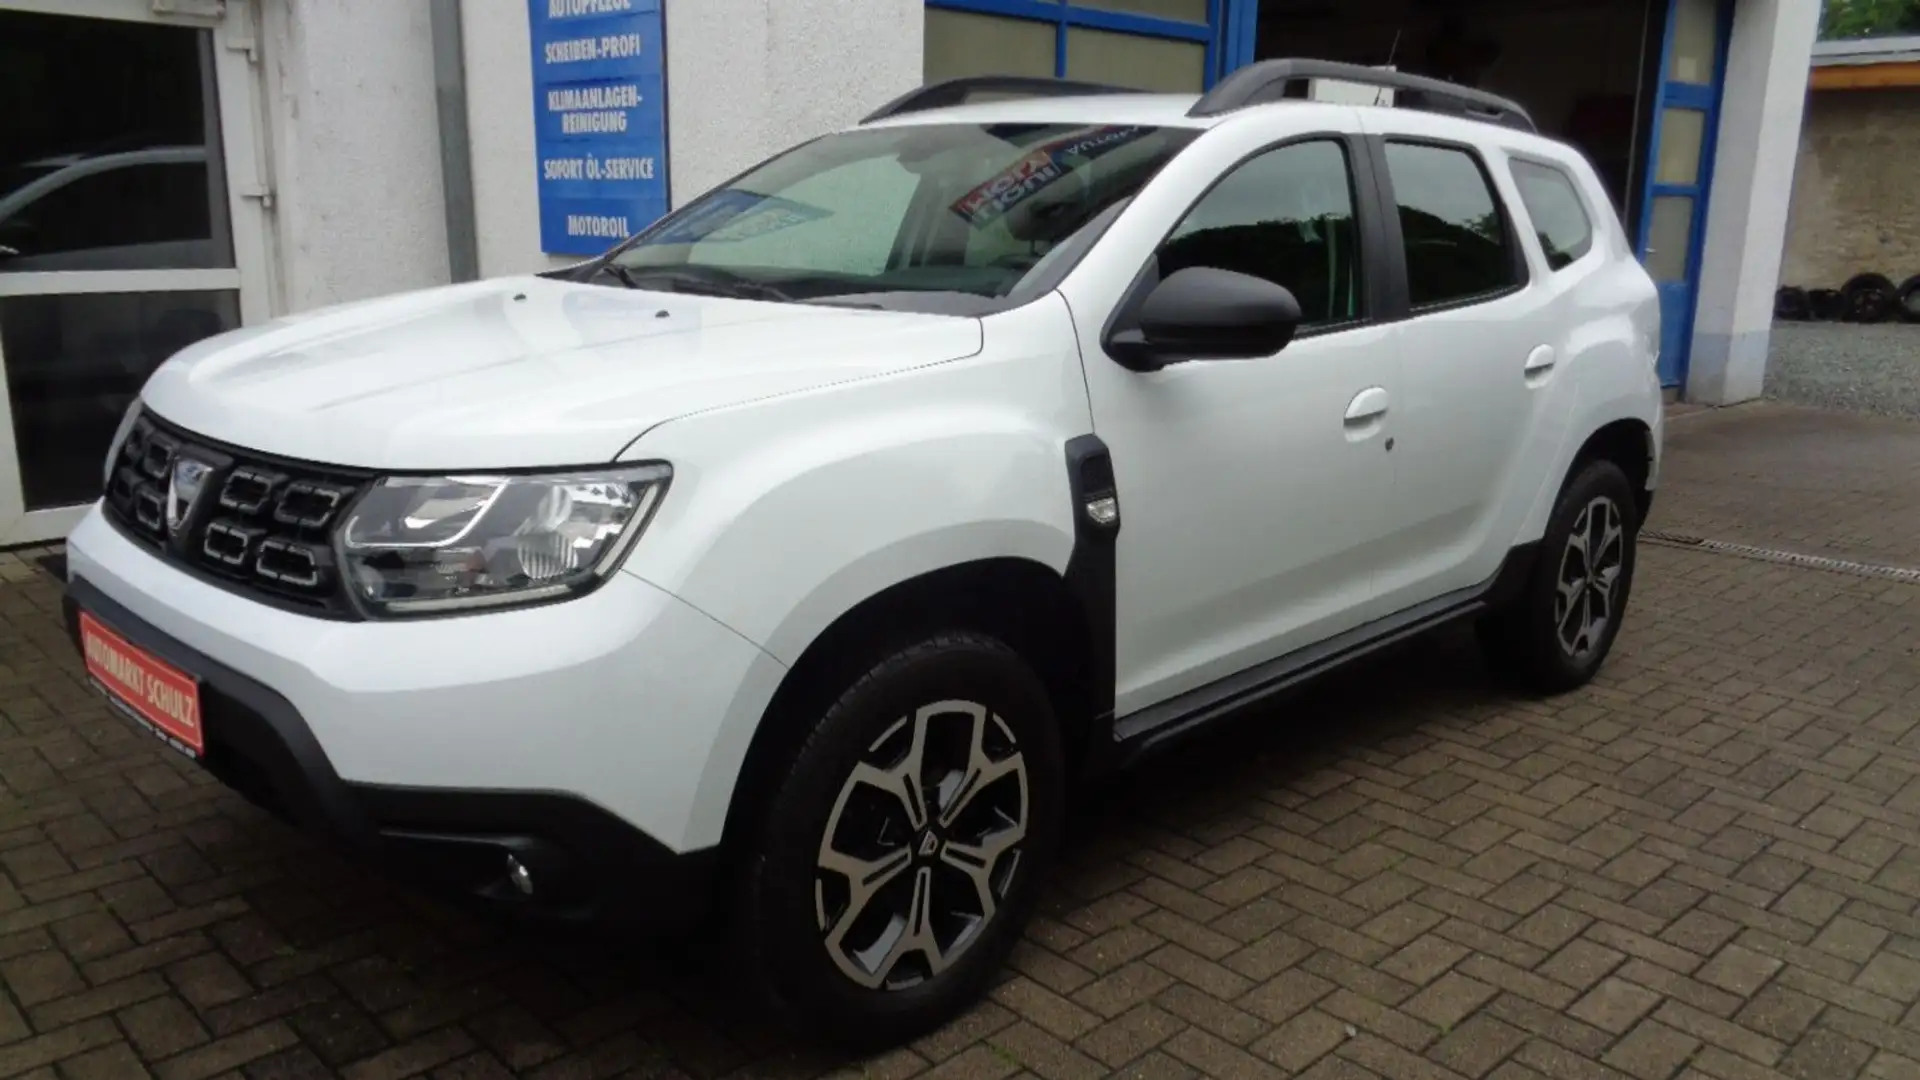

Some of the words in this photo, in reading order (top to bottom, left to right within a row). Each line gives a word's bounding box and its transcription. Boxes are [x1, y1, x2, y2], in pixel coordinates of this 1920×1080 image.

[545, 33, 640, 64] SCHEIBEN-PROFI
[548, 85, 642, 111] KLIMAANLAGEN-
[562, 111, 627, 134] REINIGUNG
[544, 158, 583, 179] SOFORT
[586, 152, 654, 179] ÖL-SERVICE
[568, 214, 630, 238] MOTOROIL
[147, 674, 195, 728] SCHULZ
